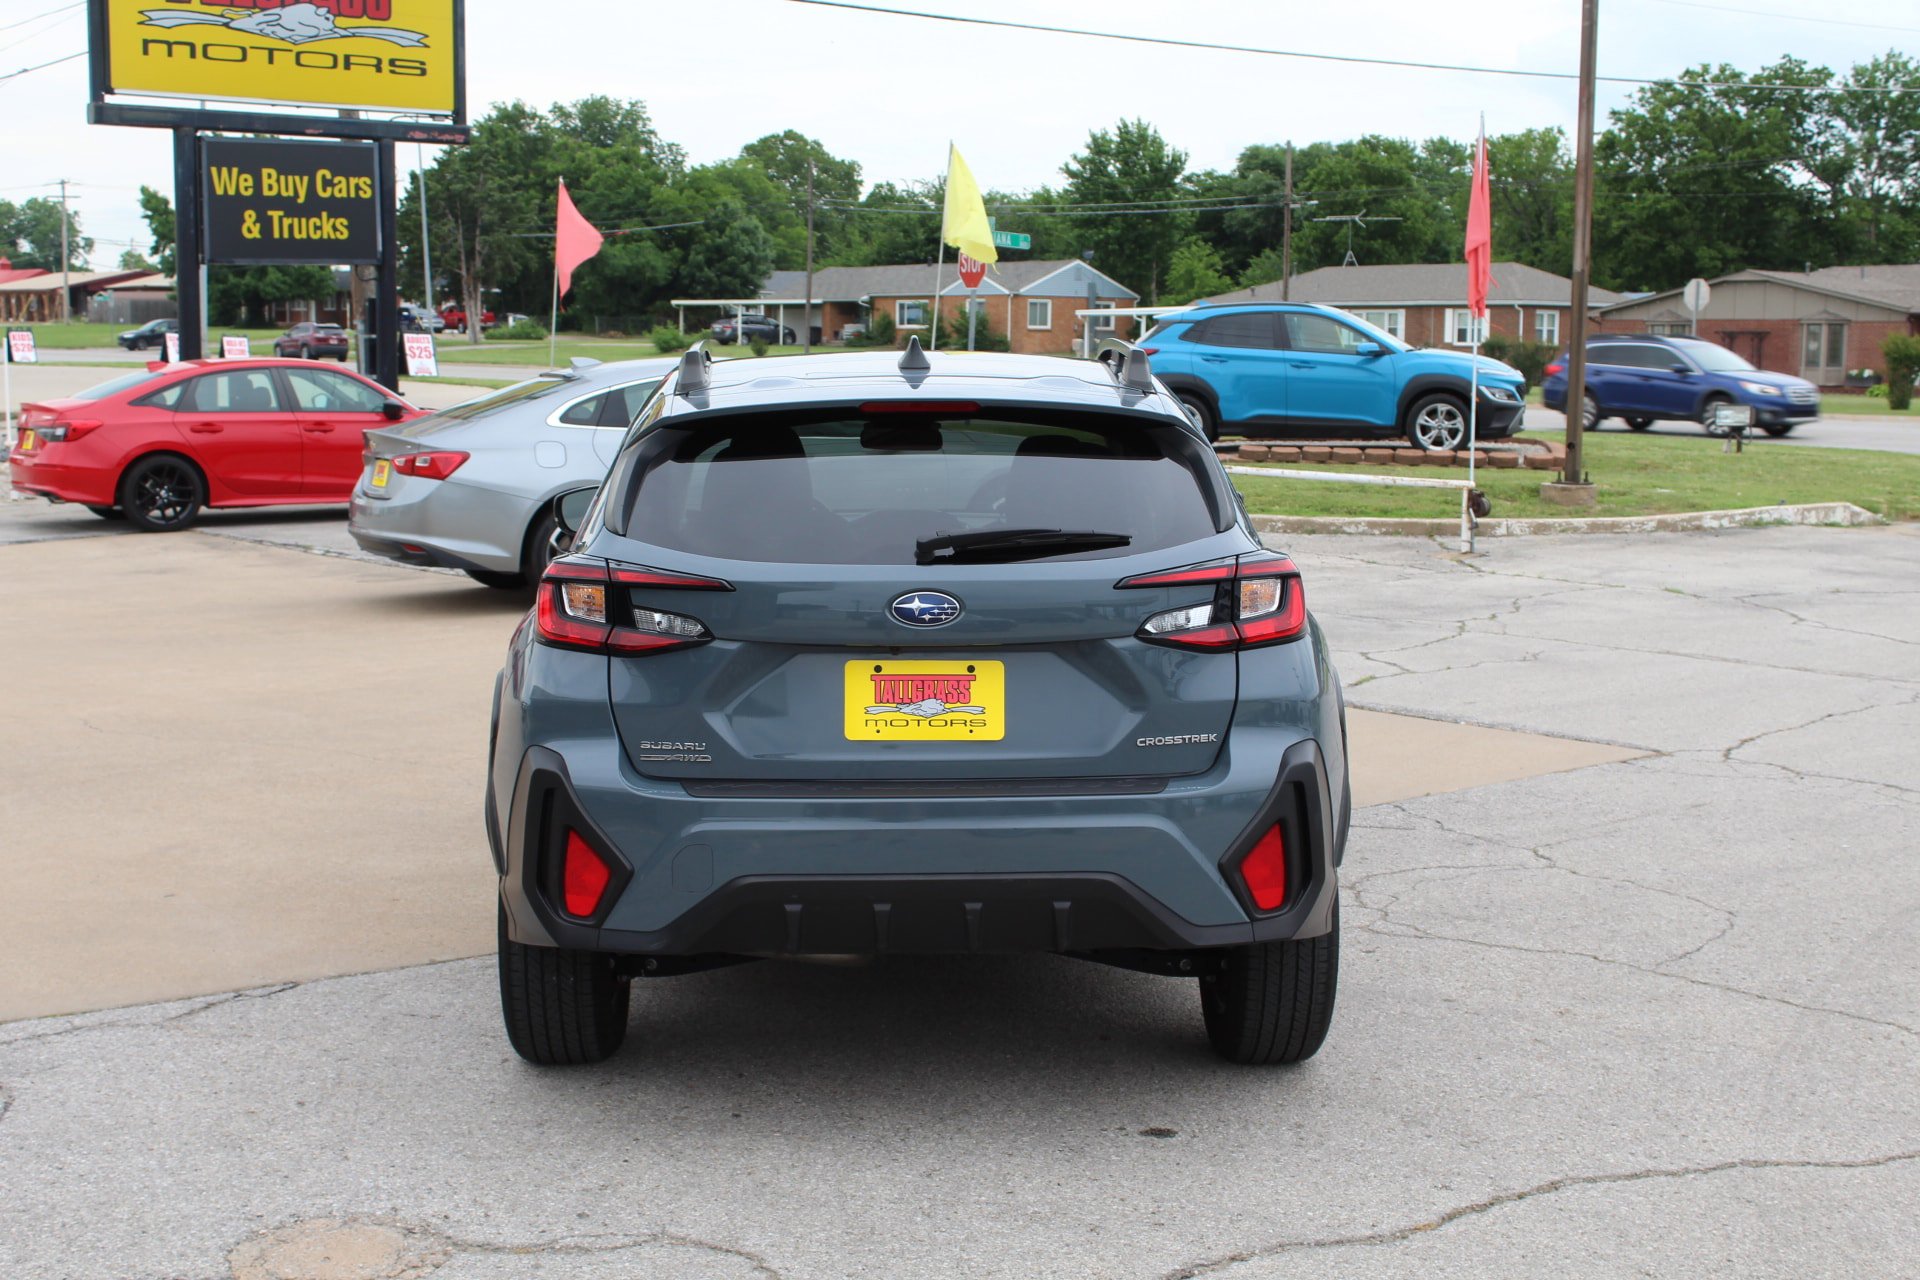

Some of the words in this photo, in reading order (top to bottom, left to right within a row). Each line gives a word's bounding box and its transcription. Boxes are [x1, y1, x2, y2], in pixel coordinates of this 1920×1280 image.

[142, 38, 427, 77] MOTORS
[210, 166, 254, 196] We
[261, 168, 309, 204] Buy
[315, 169, 372, 199] Cars
[241, 209, 262, 239] &
[267, 210, 349, 240] Trucks
[408, 345, 433, 359] $25
[871, 674, 976, 704] TALLGRASS
[865, 718, 987, 728] MOTORS
[640, 741, 706, 750] SUBARU
[1136, 733, 1218, 747] CROSSTREK
[665, 753, 712, 762] AWD
